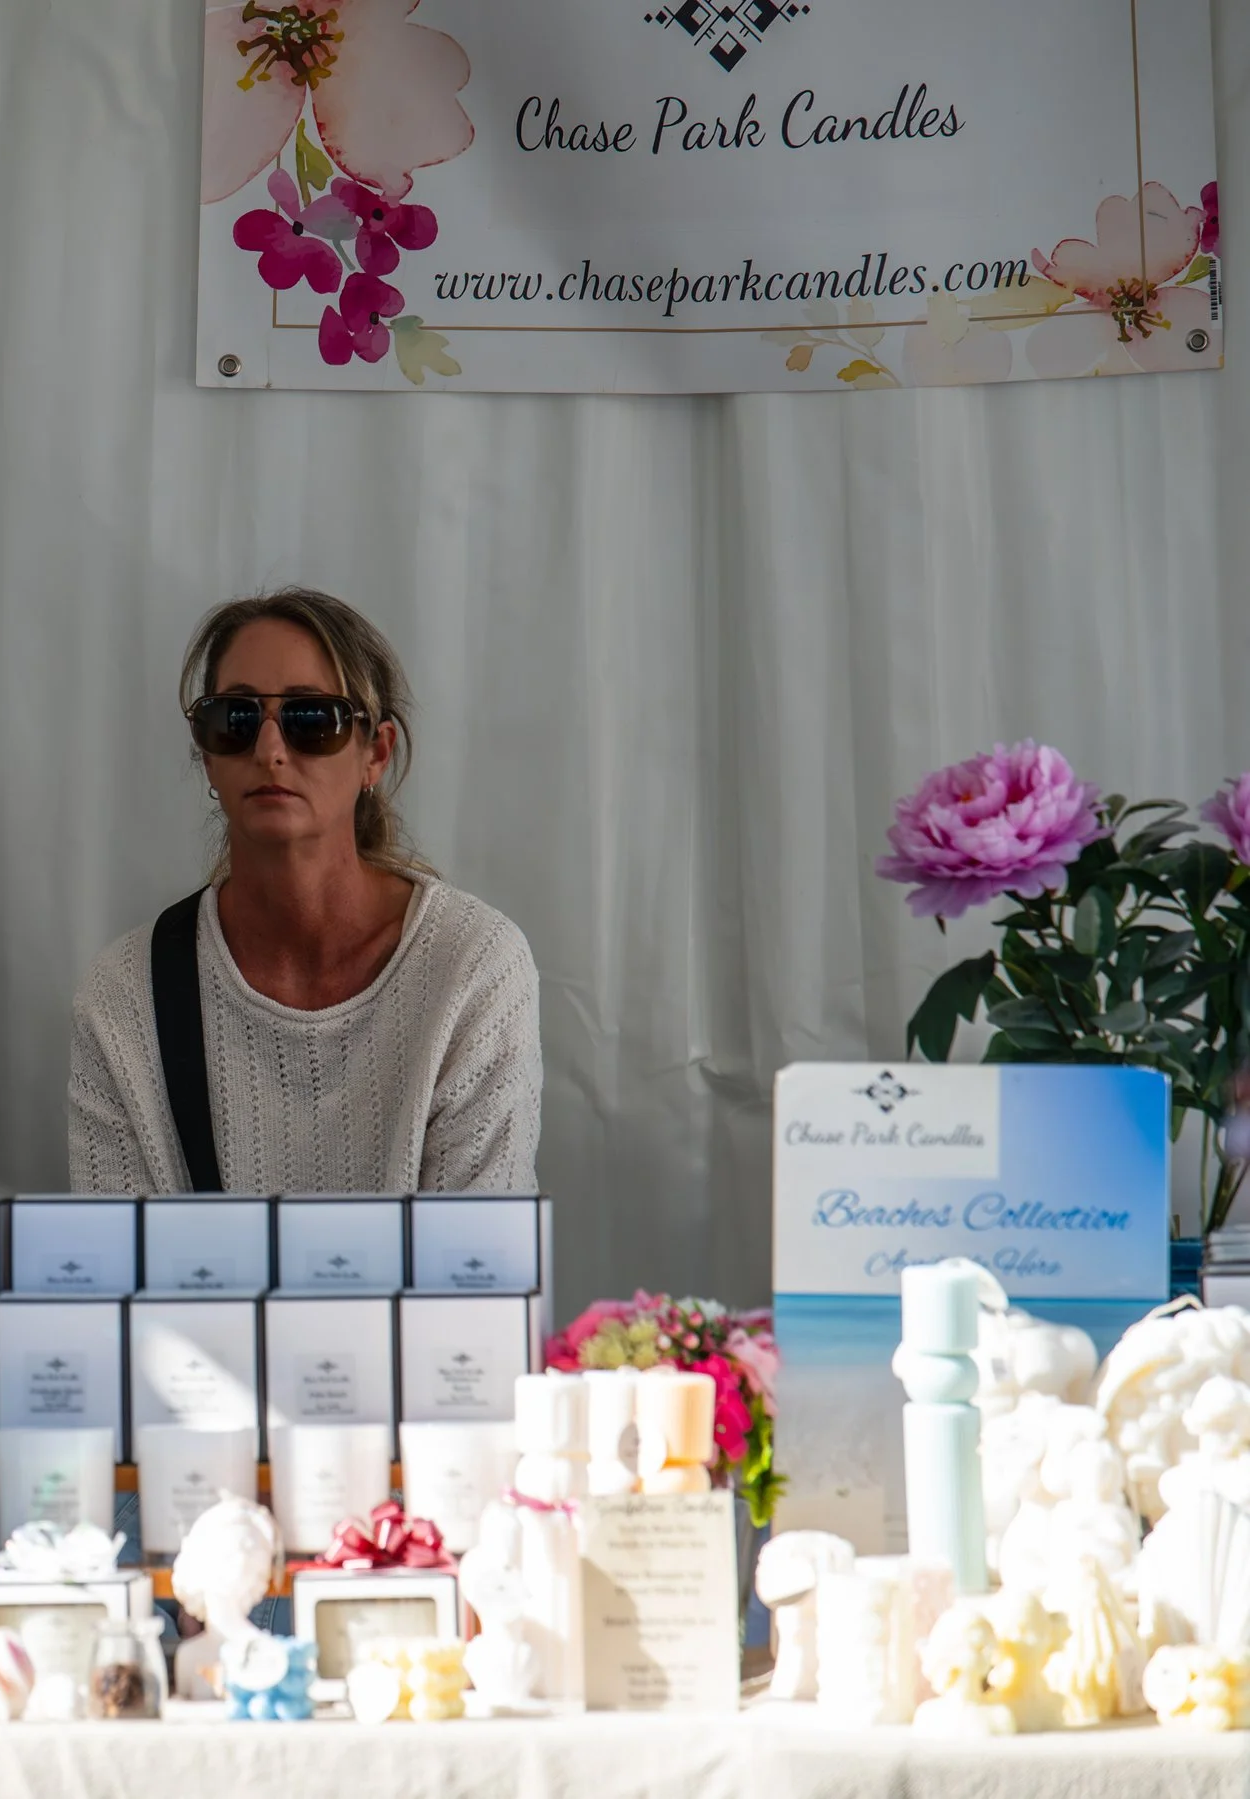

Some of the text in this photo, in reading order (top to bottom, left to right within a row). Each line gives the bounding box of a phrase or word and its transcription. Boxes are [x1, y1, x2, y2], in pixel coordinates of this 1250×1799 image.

[516, 83, 966, 155] Chase Park Candles
[434, 254, 1032, 317] www.chaseparkcandles.com
[784, 1121, 985, 1148] Chase Park Candles
[811, 1187, 1134, 1231] Beaches Collection
